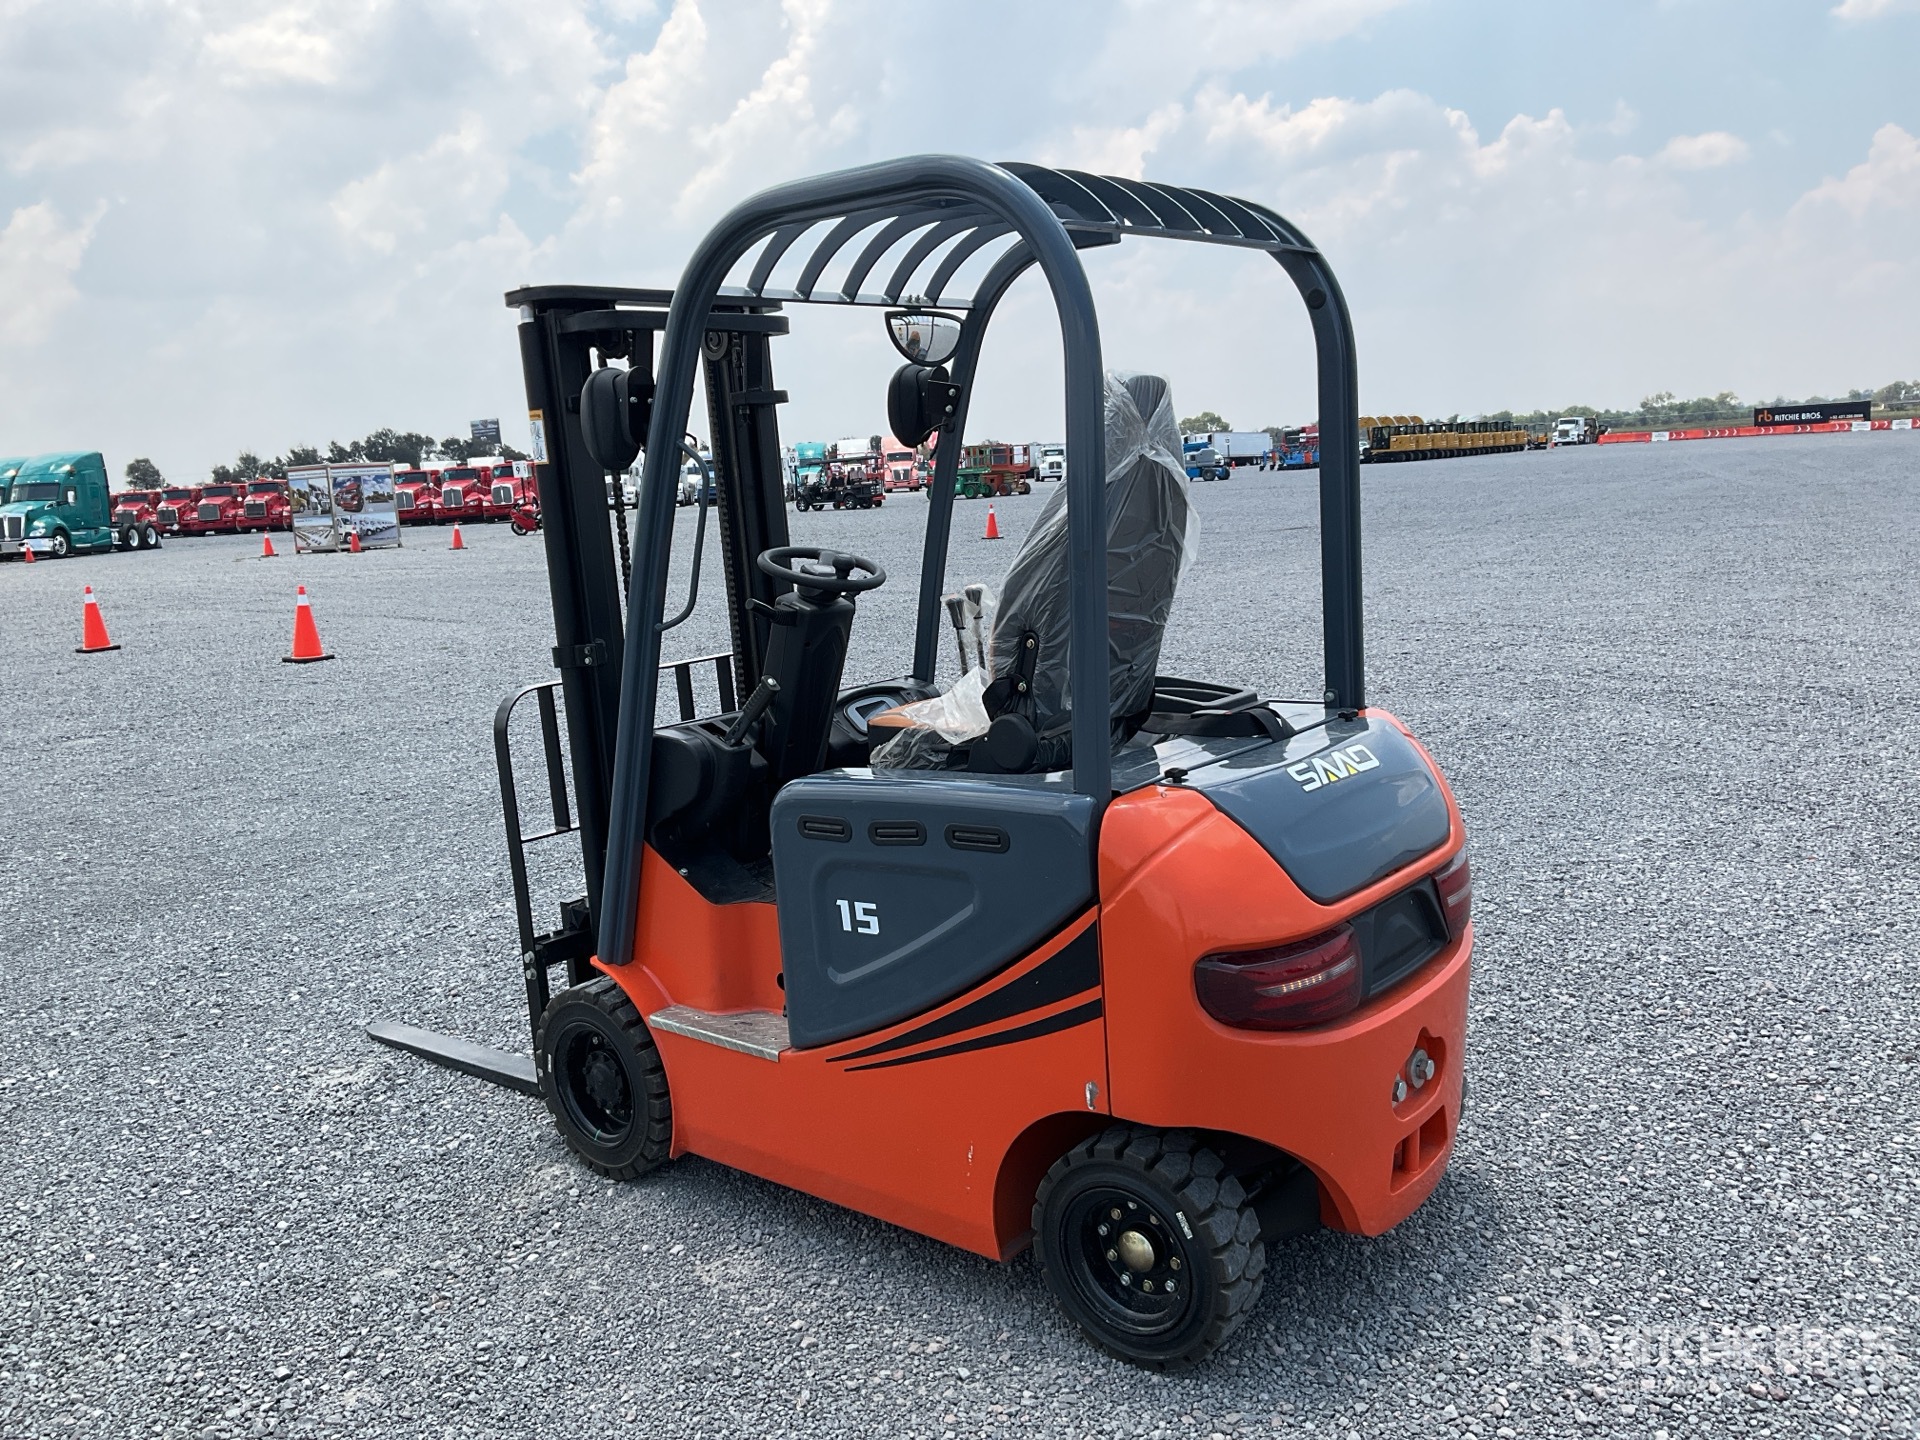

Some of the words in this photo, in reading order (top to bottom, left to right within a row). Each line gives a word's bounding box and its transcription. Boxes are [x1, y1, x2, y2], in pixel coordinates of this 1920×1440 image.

[1758, 410, 1773, 423] rb
[1774, 413, 1800, 422] RITCHIE
[789, 456, 796, 464] 10
[515, 466, 521, 475] 9
[835, 899, 880, 936] 15
